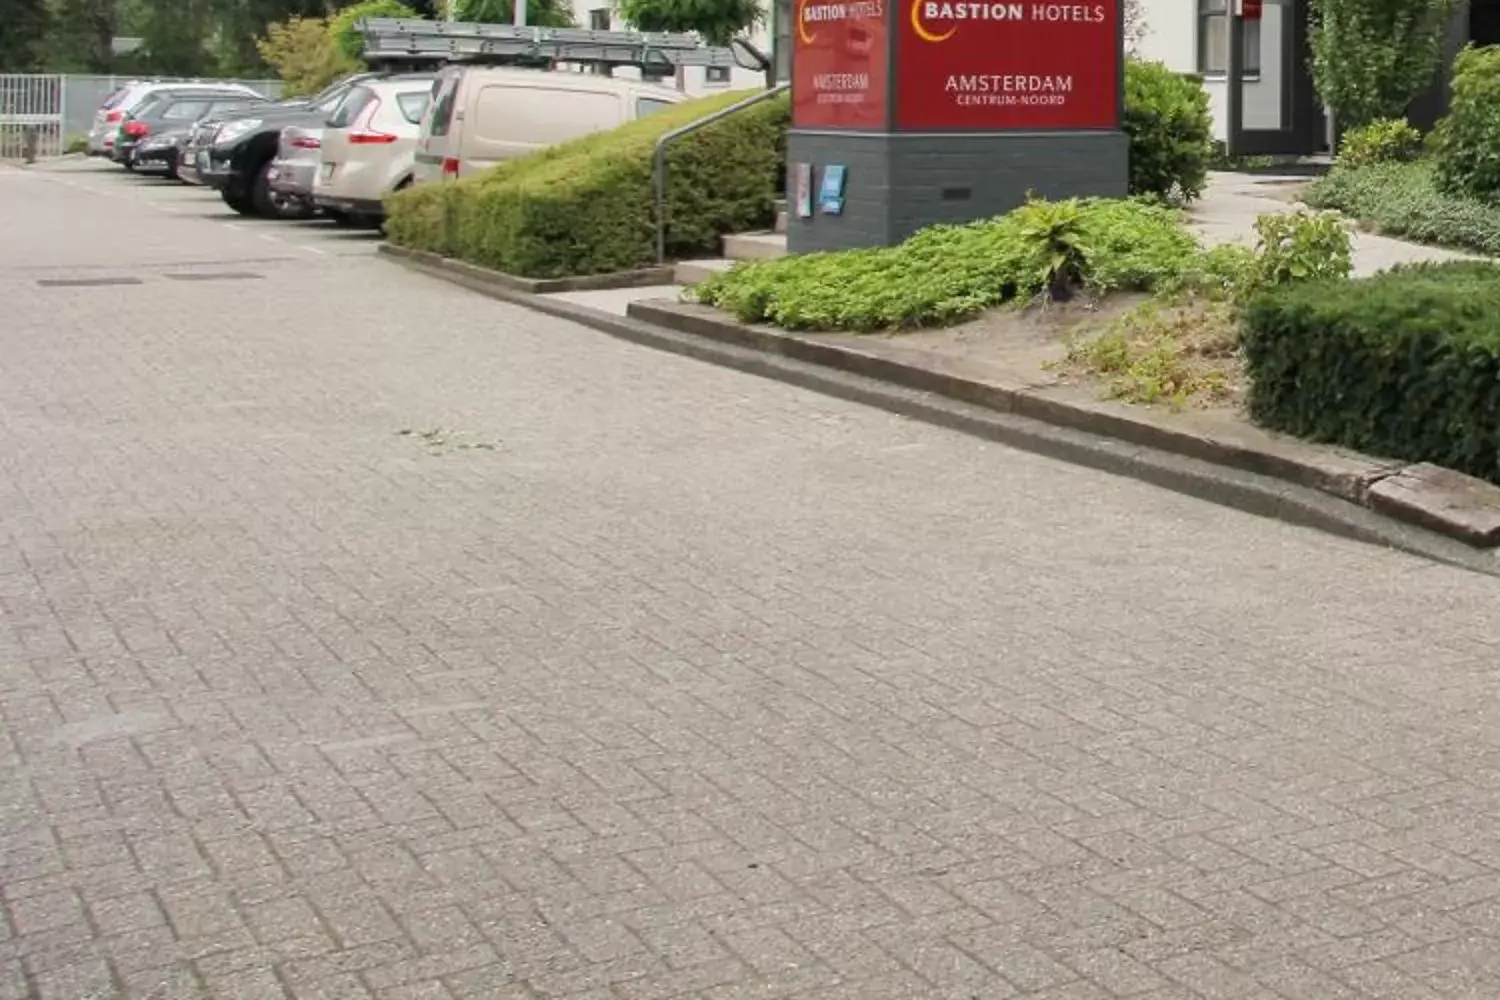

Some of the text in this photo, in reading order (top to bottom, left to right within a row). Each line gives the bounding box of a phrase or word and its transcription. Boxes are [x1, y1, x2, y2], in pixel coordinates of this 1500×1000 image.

[804, 4, 845, 22] BASTION
[924, 1, 1105, 22] BASTION HOTELS
[944, 74, 1073, 92] AMSTERDAM
